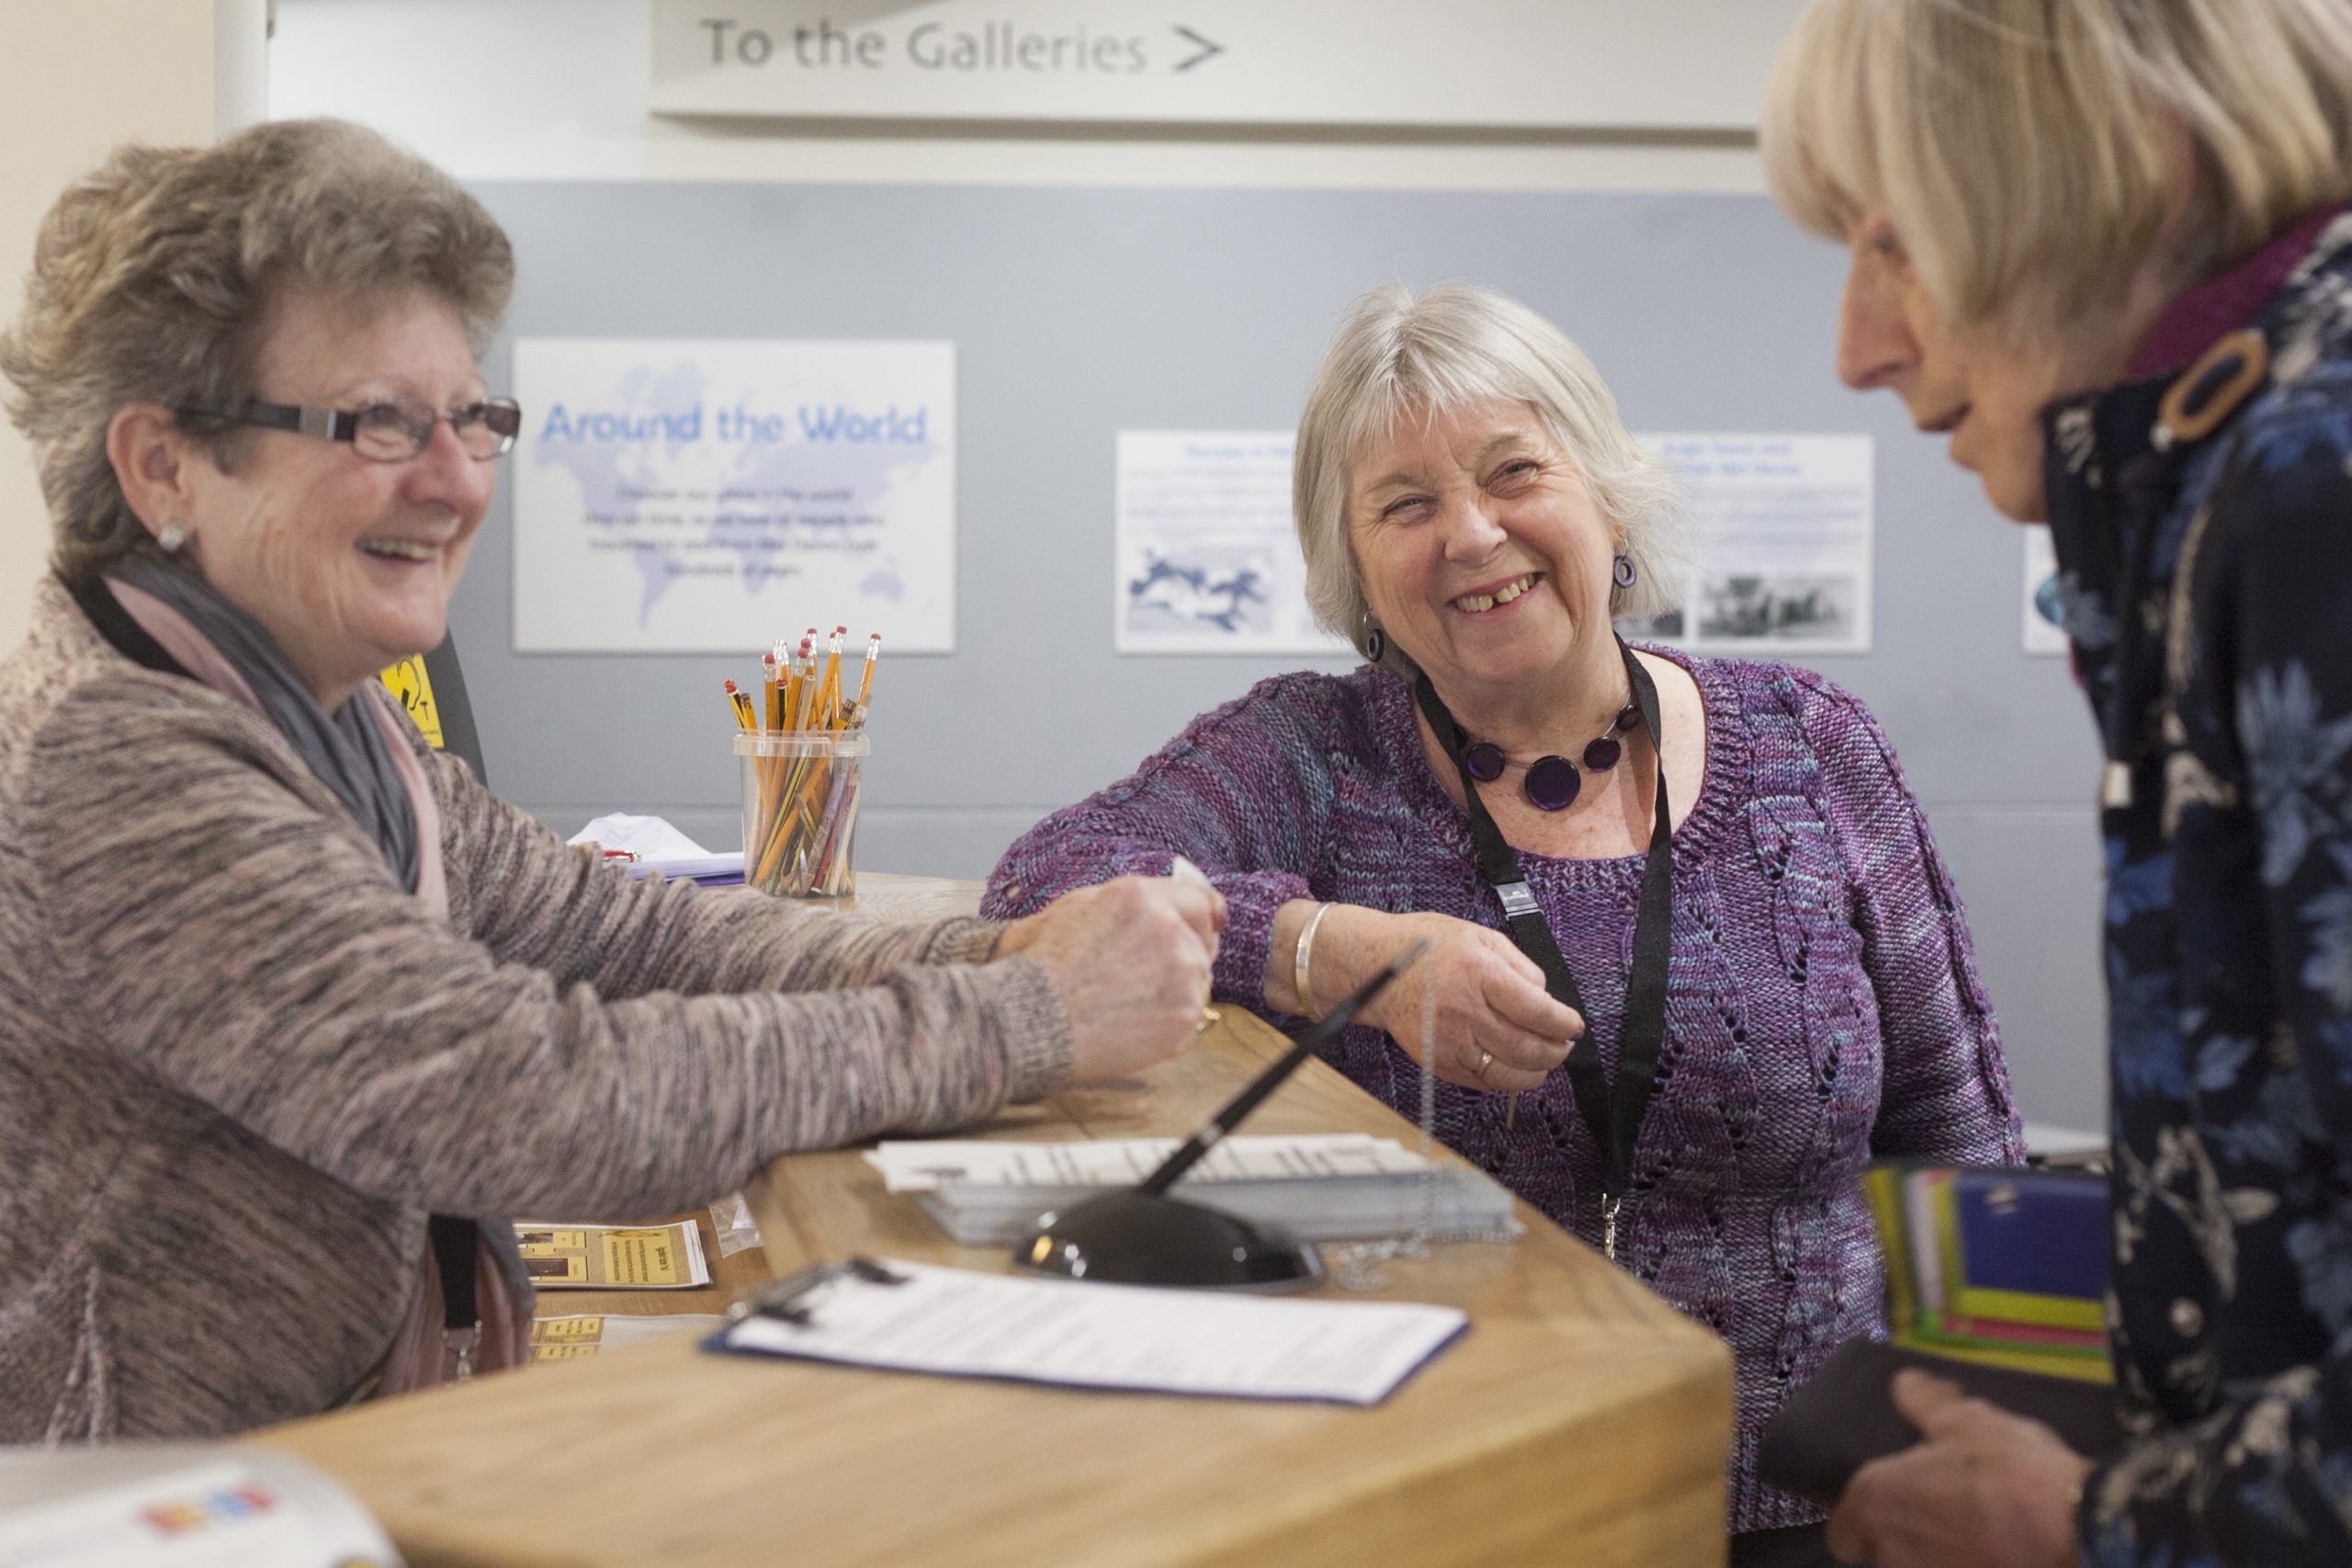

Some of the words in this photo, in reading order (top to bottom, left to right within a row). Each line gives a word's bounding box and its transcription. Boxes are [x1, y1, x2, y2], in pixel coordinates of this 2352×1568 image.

[699, 18, 773, 67] To
[793, 17, 887, 69] the
[905, 19, 1148, 73] Galleries
[540, 402, 704, 443] Around
[718, 404, 785, 443] the
[797, 404, 927, 444] World
